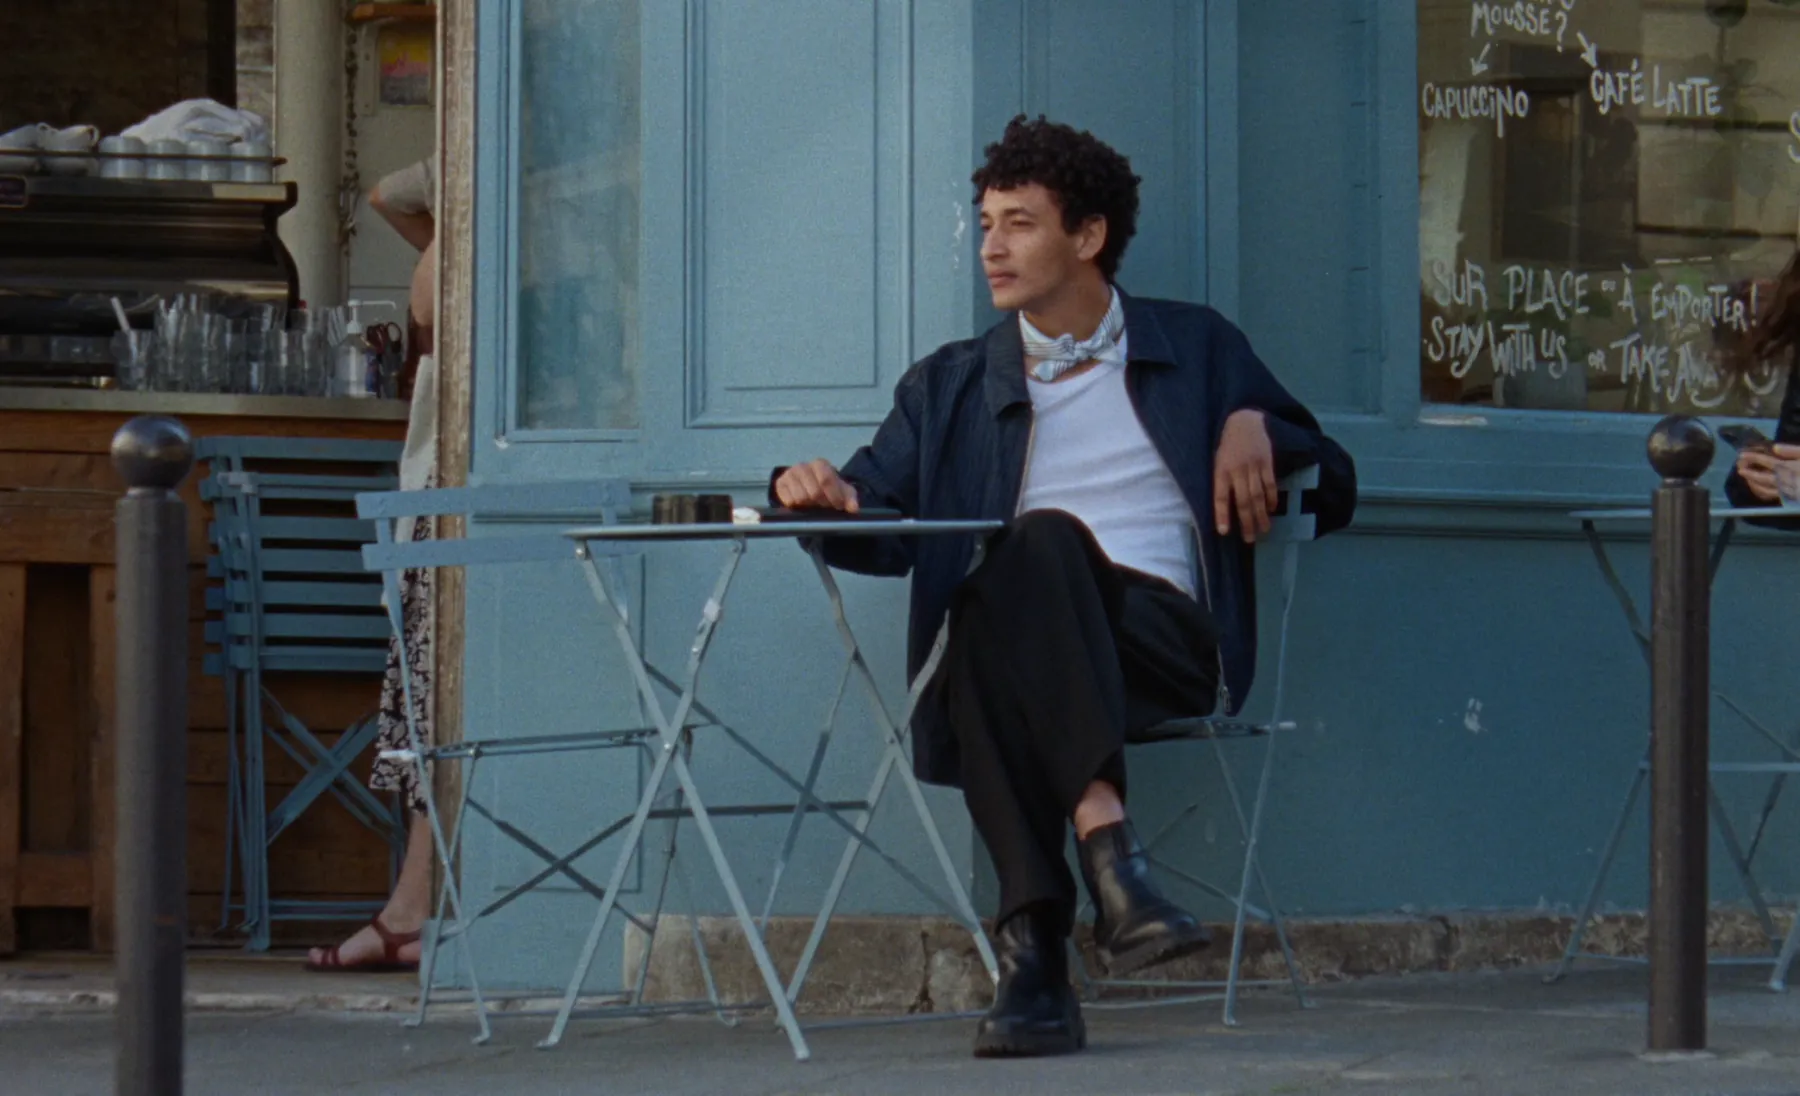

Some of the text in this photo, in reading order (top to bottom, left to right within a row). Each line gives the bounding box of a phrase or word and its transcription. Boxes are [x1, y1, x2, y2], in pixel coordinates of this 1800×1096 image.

[1590, 58, 1723, 117] CAFÉ LATTE
[1432, 260, 1488, 312] SUR
[1502, 264, 1590, 321] PLACE
[1617, 263, 1638, 325] À
[1427, 316, 1485, 378] STAY
[1541, 327, 1568, 379] US
[1609, 333, 1670, 393] TAKE
